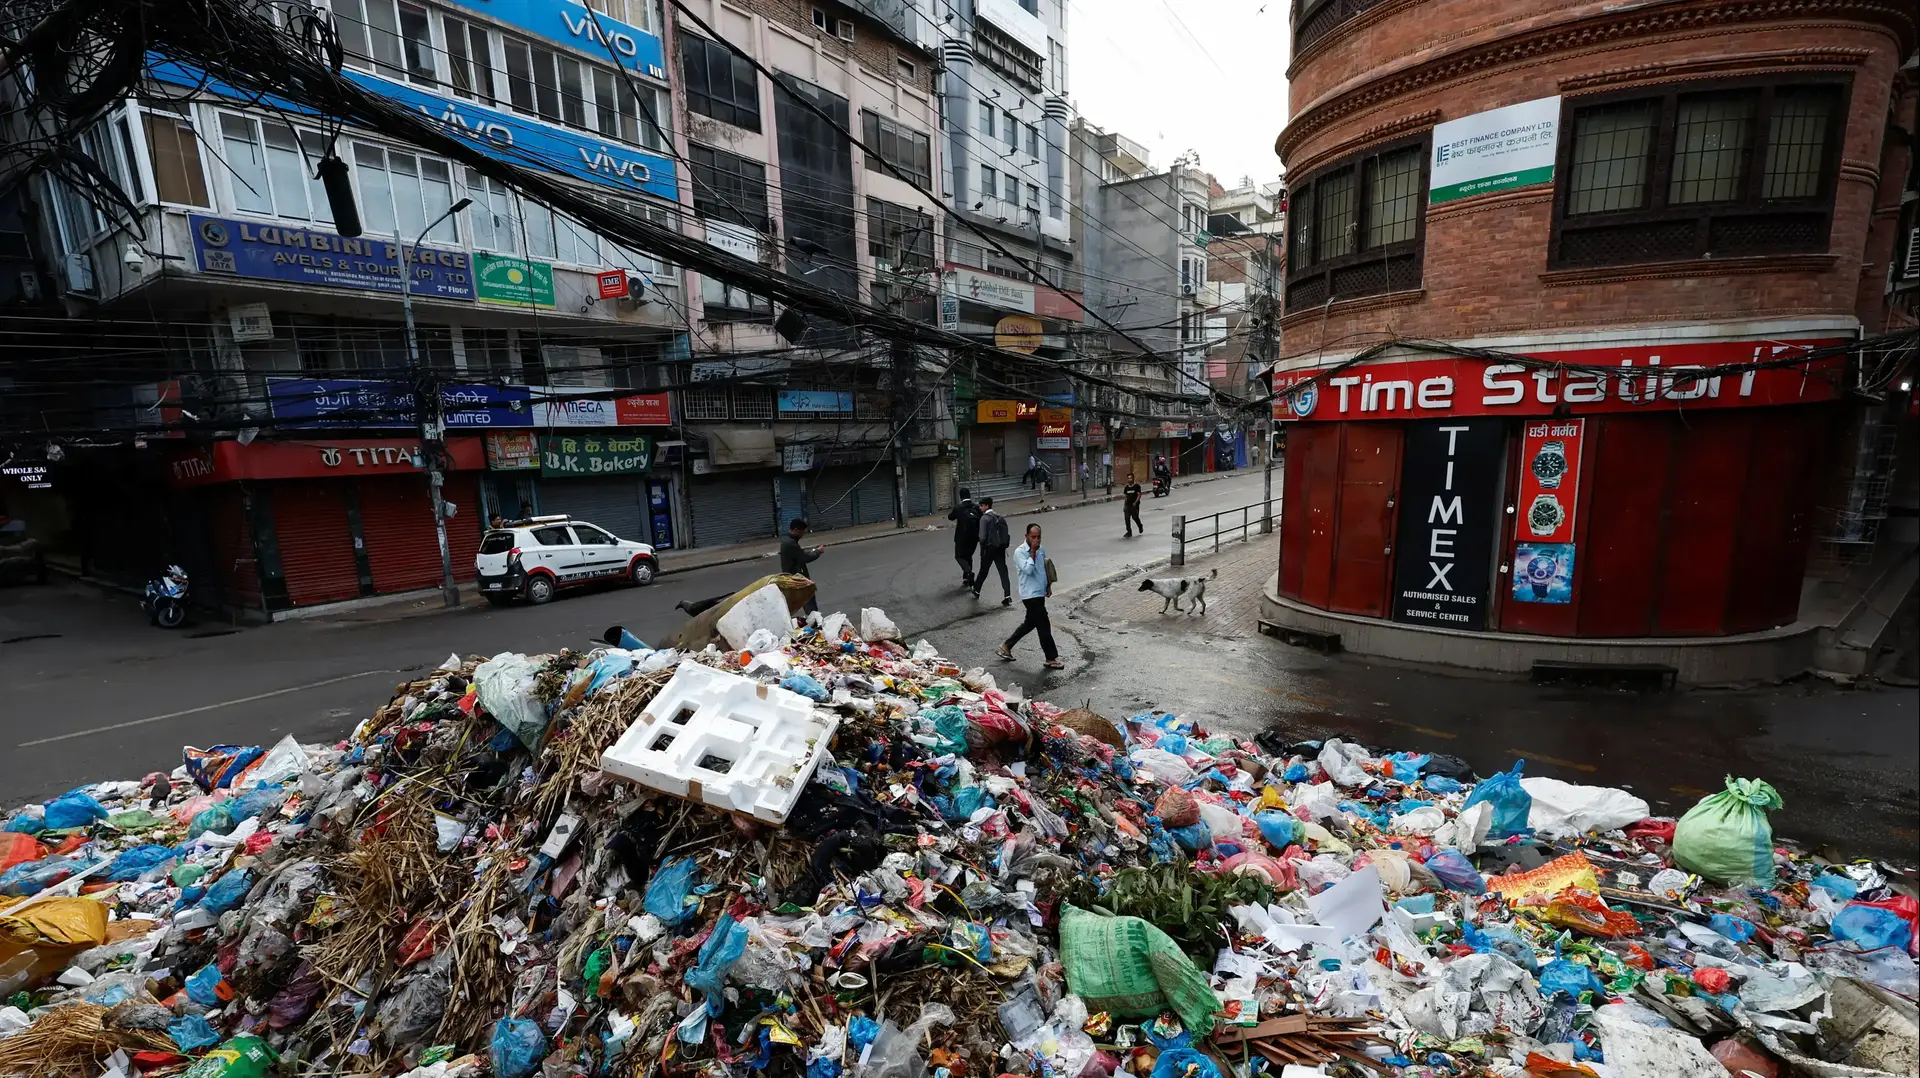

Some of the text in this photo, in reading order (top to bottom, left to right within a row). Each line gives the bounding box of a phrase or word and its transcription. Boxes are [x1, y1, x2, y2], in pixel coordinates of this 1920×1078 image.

[562, 10, 637, 56] vivo
[419, 103, 514, 147] vivo
[1451, 121, 1553, 149] BEST FINANCE COMPANY LTD.
[579, 145, 651, 182] vivo
[240, 223, 373, 258] LUMBINI
[338, 259, 350, 270] &
[416, 266, 434, 281] (P)
[448, 286, 469, 295] Floor
[979, 280, 998, 292] Global
[1330, 373, 1454, 412] Time
[568, 401, 604, 413] MEGA
[446, 413, 491, 424] LIMITED
[1529, 422, 1577, 438] घडी मर्मत
[607, 437, 645, 453] बेकरी
[2, 466, 33, 475] WHOLE
[545, 451, 649, 473] B.K. Bakery
[1425, 426, 1470, 591] TIMEX
[1402, 590, 1477, 604] AUTHORISED SALES
[1406, 609, 1470, 623] SERVICE CENTER
